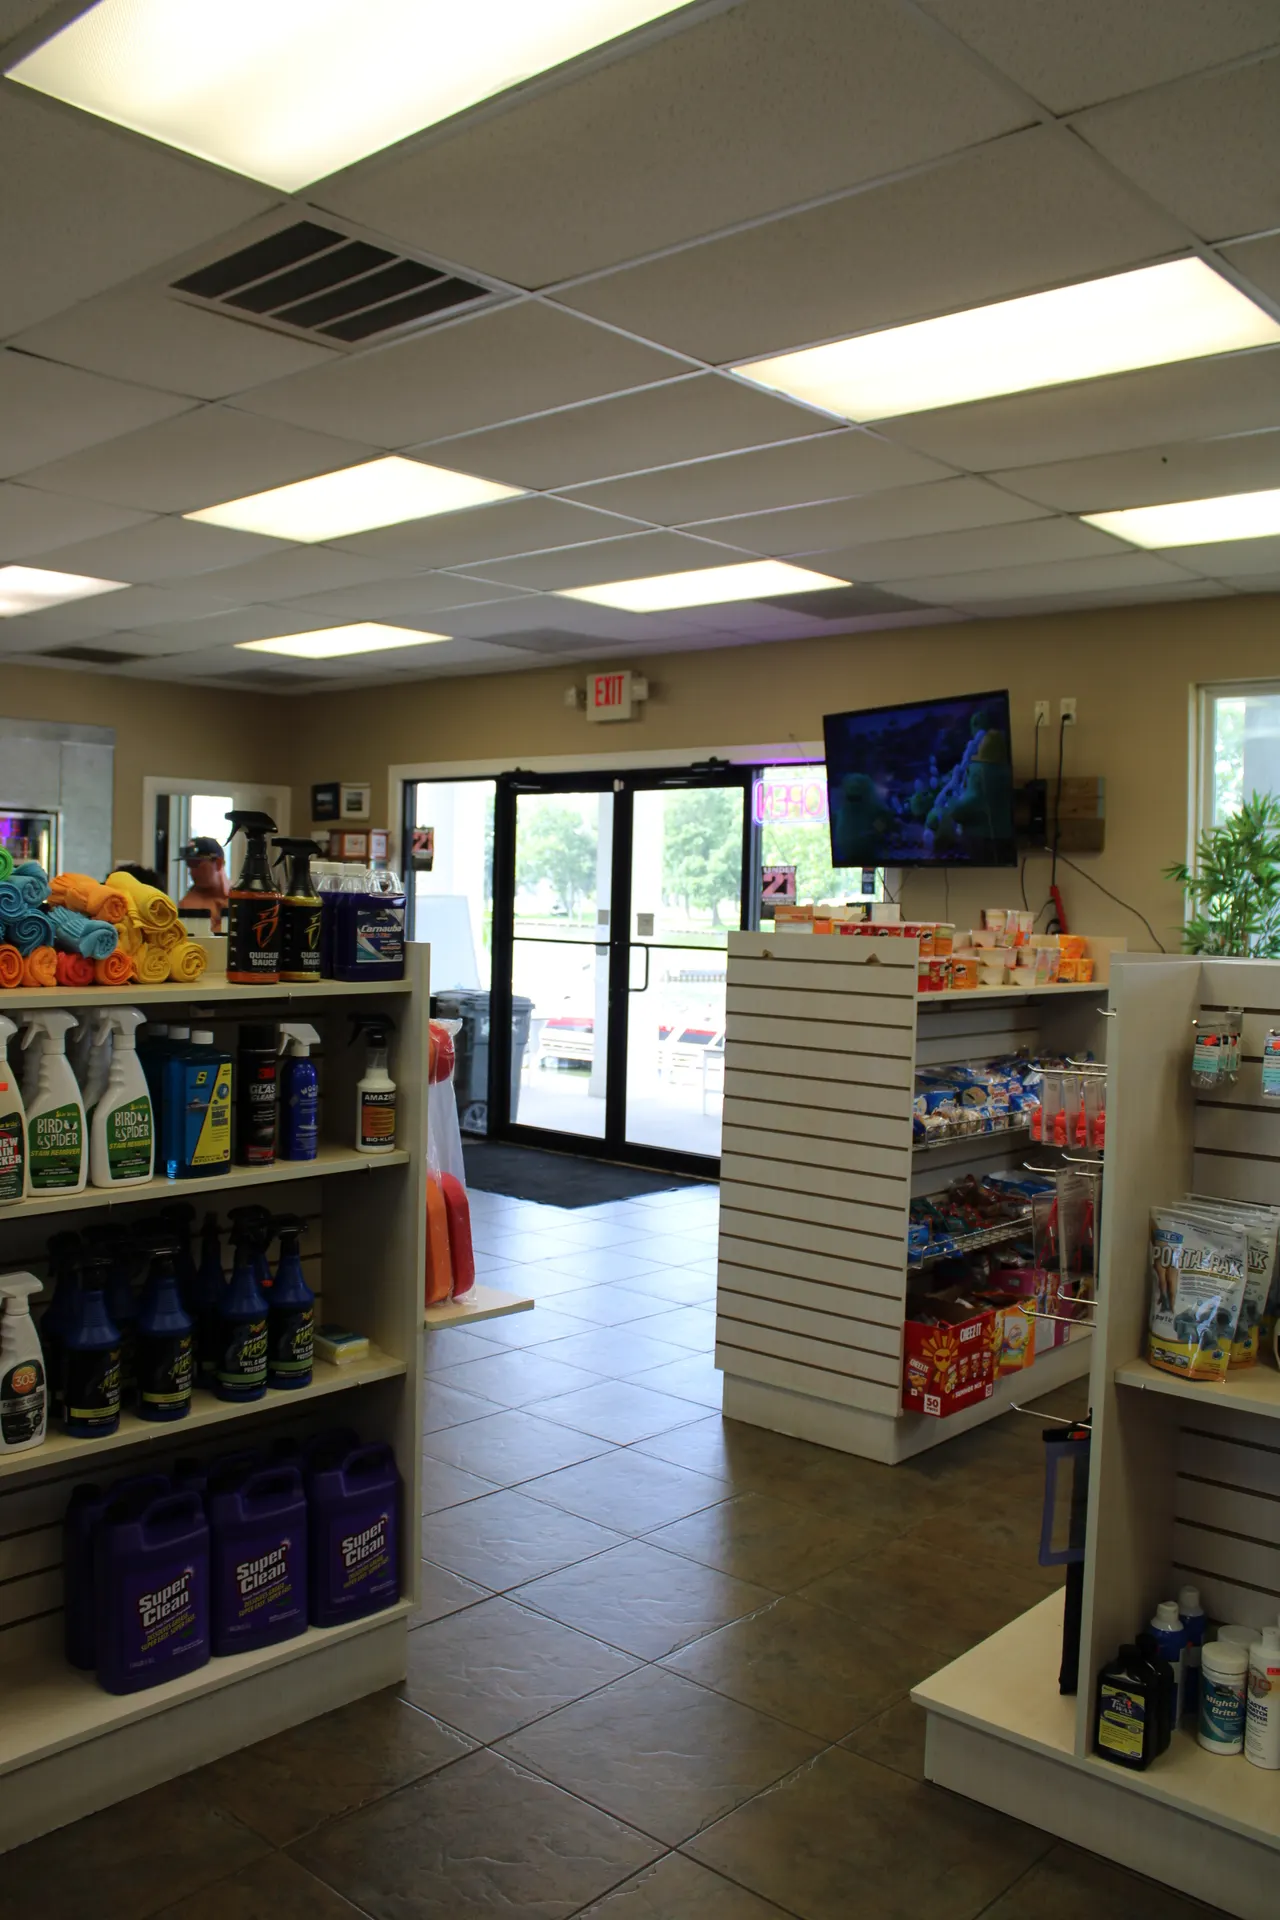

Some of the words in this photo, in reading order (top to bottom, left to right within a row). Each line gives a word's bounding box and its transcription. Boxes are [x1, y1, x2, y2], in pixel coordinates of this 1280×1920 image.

[595, 676, 624, 707] EXIT
[411, 832, 433, 853] 21
[762, 873, 796, 898] 21
[249, 952, 280, 960] QUICKIE
[37, 1118, 63, 1134] BIRD
[115, 1111, 136, 1126] BIRD
[30, 1149, 51, 1157] STAIN
[15, 1371, 36, 1387] 303
[927, 1398, 939, 1408] 50
[341, 1519, 385, 1555] Super
[344, 1534, 385, 1568] Clean
[236, 1545, 287, 1581] Super
[240, 1561, 286, 1595] Clean
[138, 1573, 191, 1614] Super
[142, 1590, 189, 1628] Clean
[1206, 1694, 1239, 1708] Mighty
[1211, 1706, 1237, 1717] Brite
